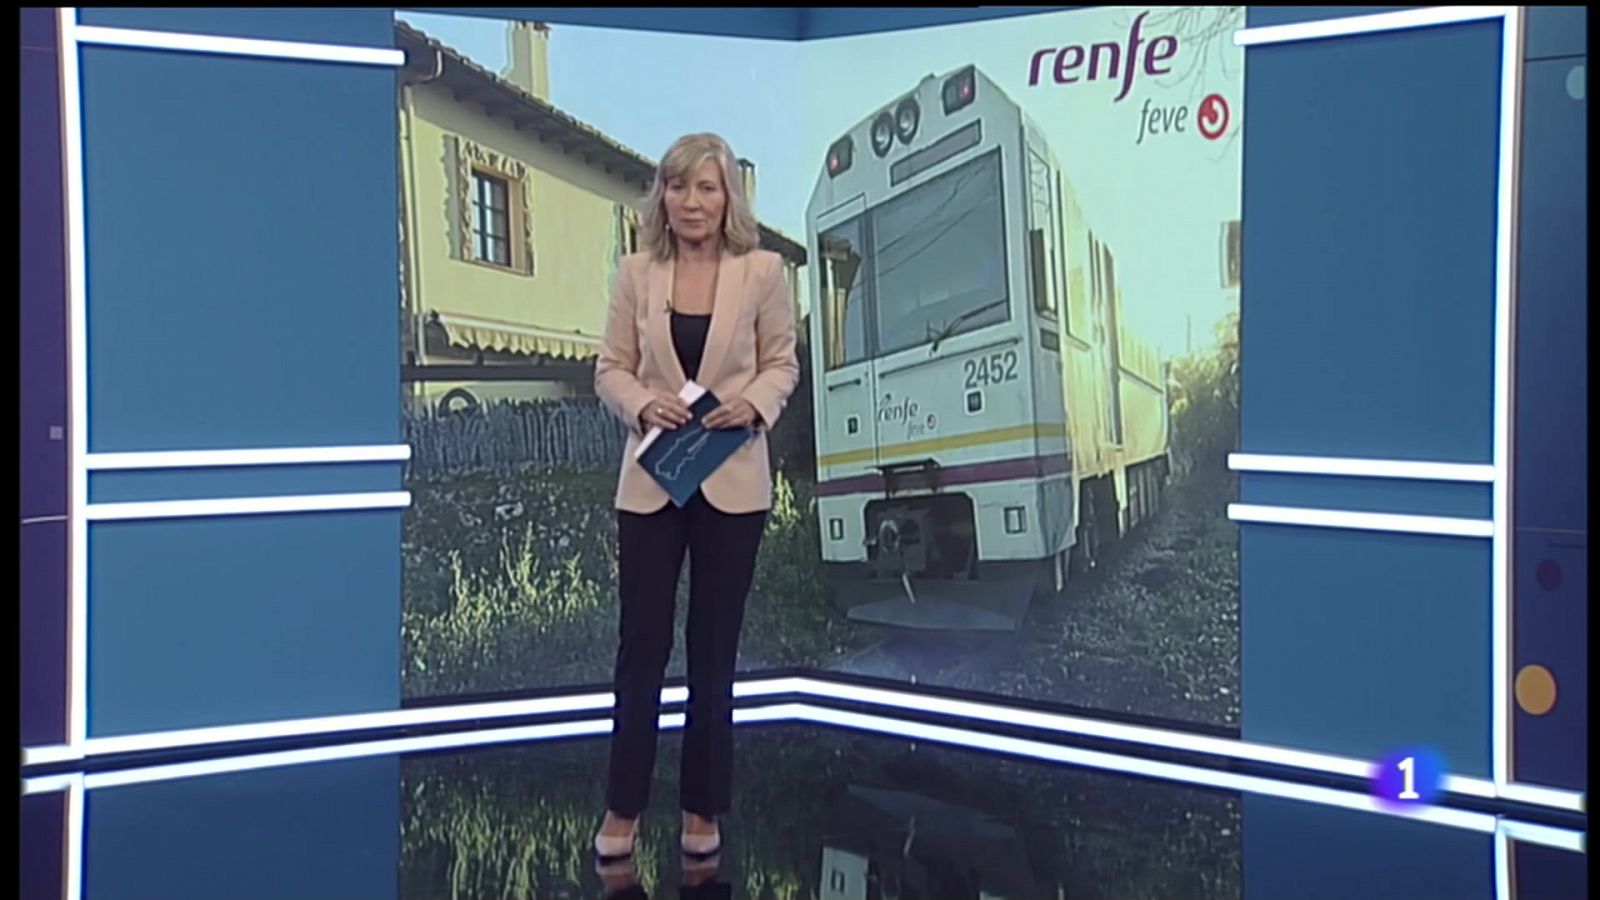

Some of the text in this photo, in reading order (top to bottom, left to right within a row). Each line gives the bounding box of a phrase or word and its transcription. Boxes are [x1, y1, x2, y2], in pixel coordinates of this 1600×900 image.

[1028, 11, 1177, 102] renfe
[1136, 98, 1188, 144] feve
[964, 351, 1018, 388] 2452
[878, 396, 918, 426] renfe
